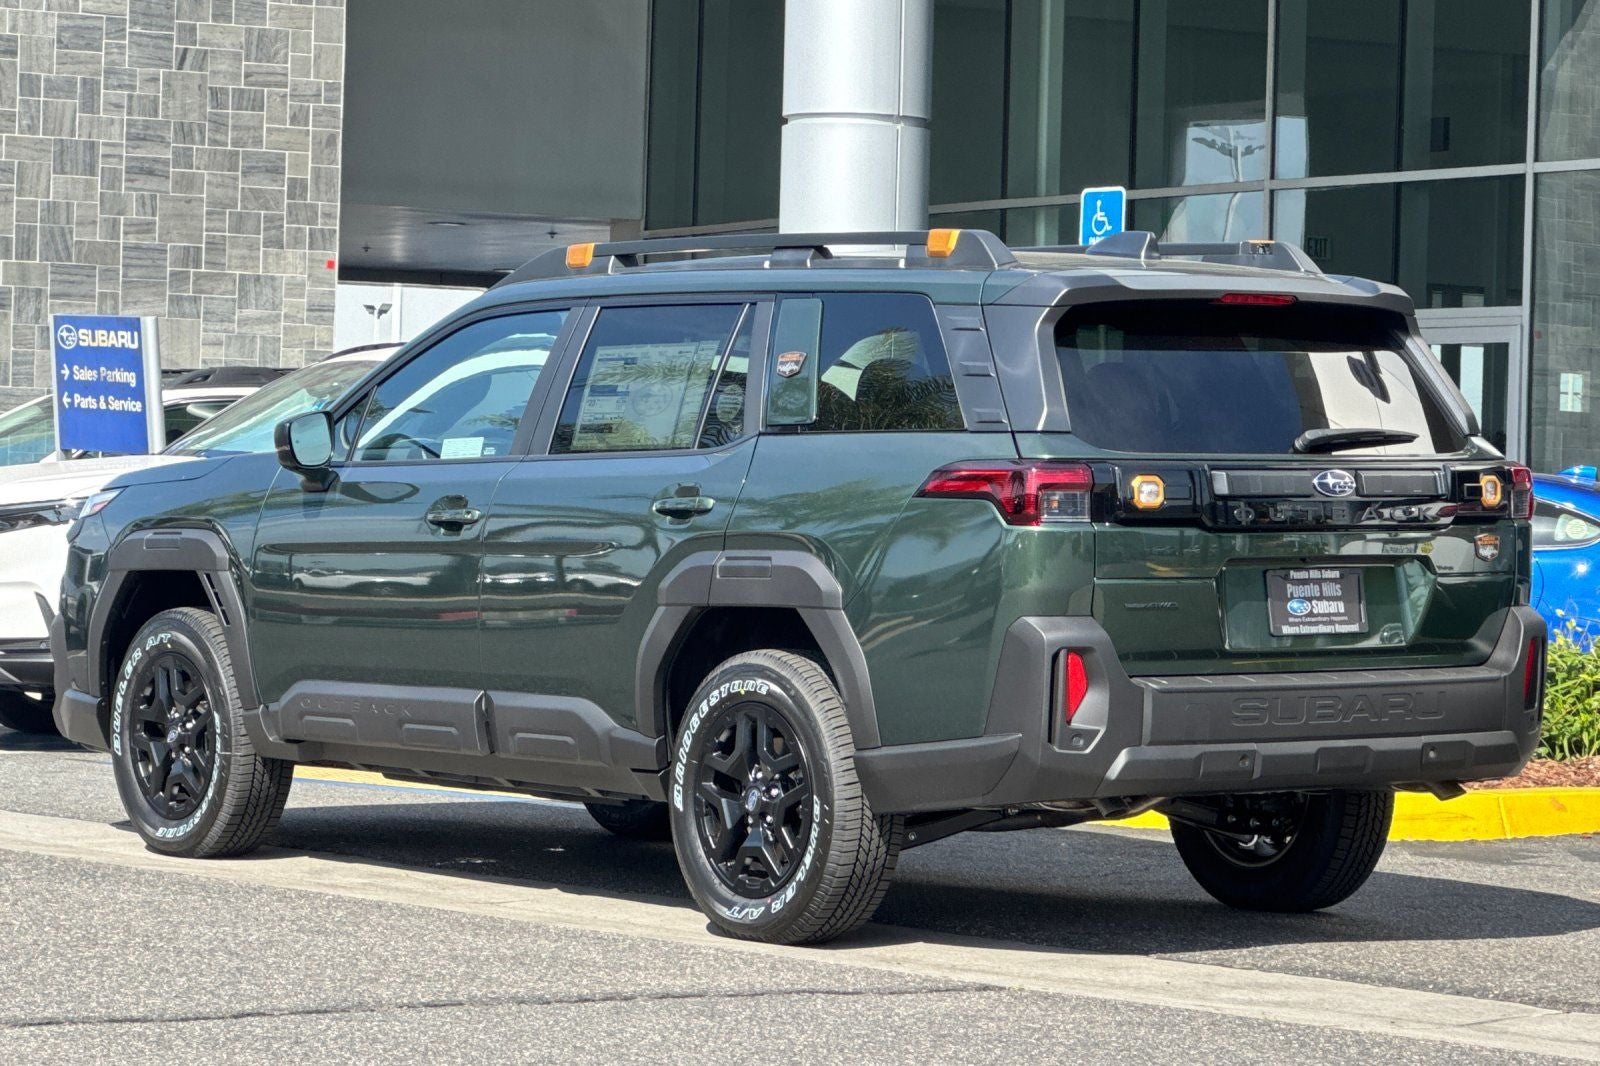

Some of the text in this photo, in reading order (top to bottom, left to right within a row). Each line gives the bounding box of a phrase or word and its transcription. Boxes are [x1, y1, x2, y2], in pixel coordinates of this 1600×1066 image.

[78, 329, 139, 349] SUBARU
[73, 365, 137, 388] Sales Parking
[74, 393, 142, 412] Parts & Service
[1234, 505, 1433, 525] OUTBACK
[1289, 570, 1308, 579] Puente
[1321, 569, 1340, 578] Subaru
[1287, 581, 1342, 598] Puente Hills
[1312, 599, 1345, 614] Subaru
[1281, 625, 1300, 634] Where
[1300, 624, 1335, 634] Extraordinary
[113, 633, 172, 756] DUELER A/T
[1231, 691, 1446, 727] SUBARU
[673, 679, 770, 812] BRIDGESTONE
[725, 794, 821, 920] DUELER A/T
